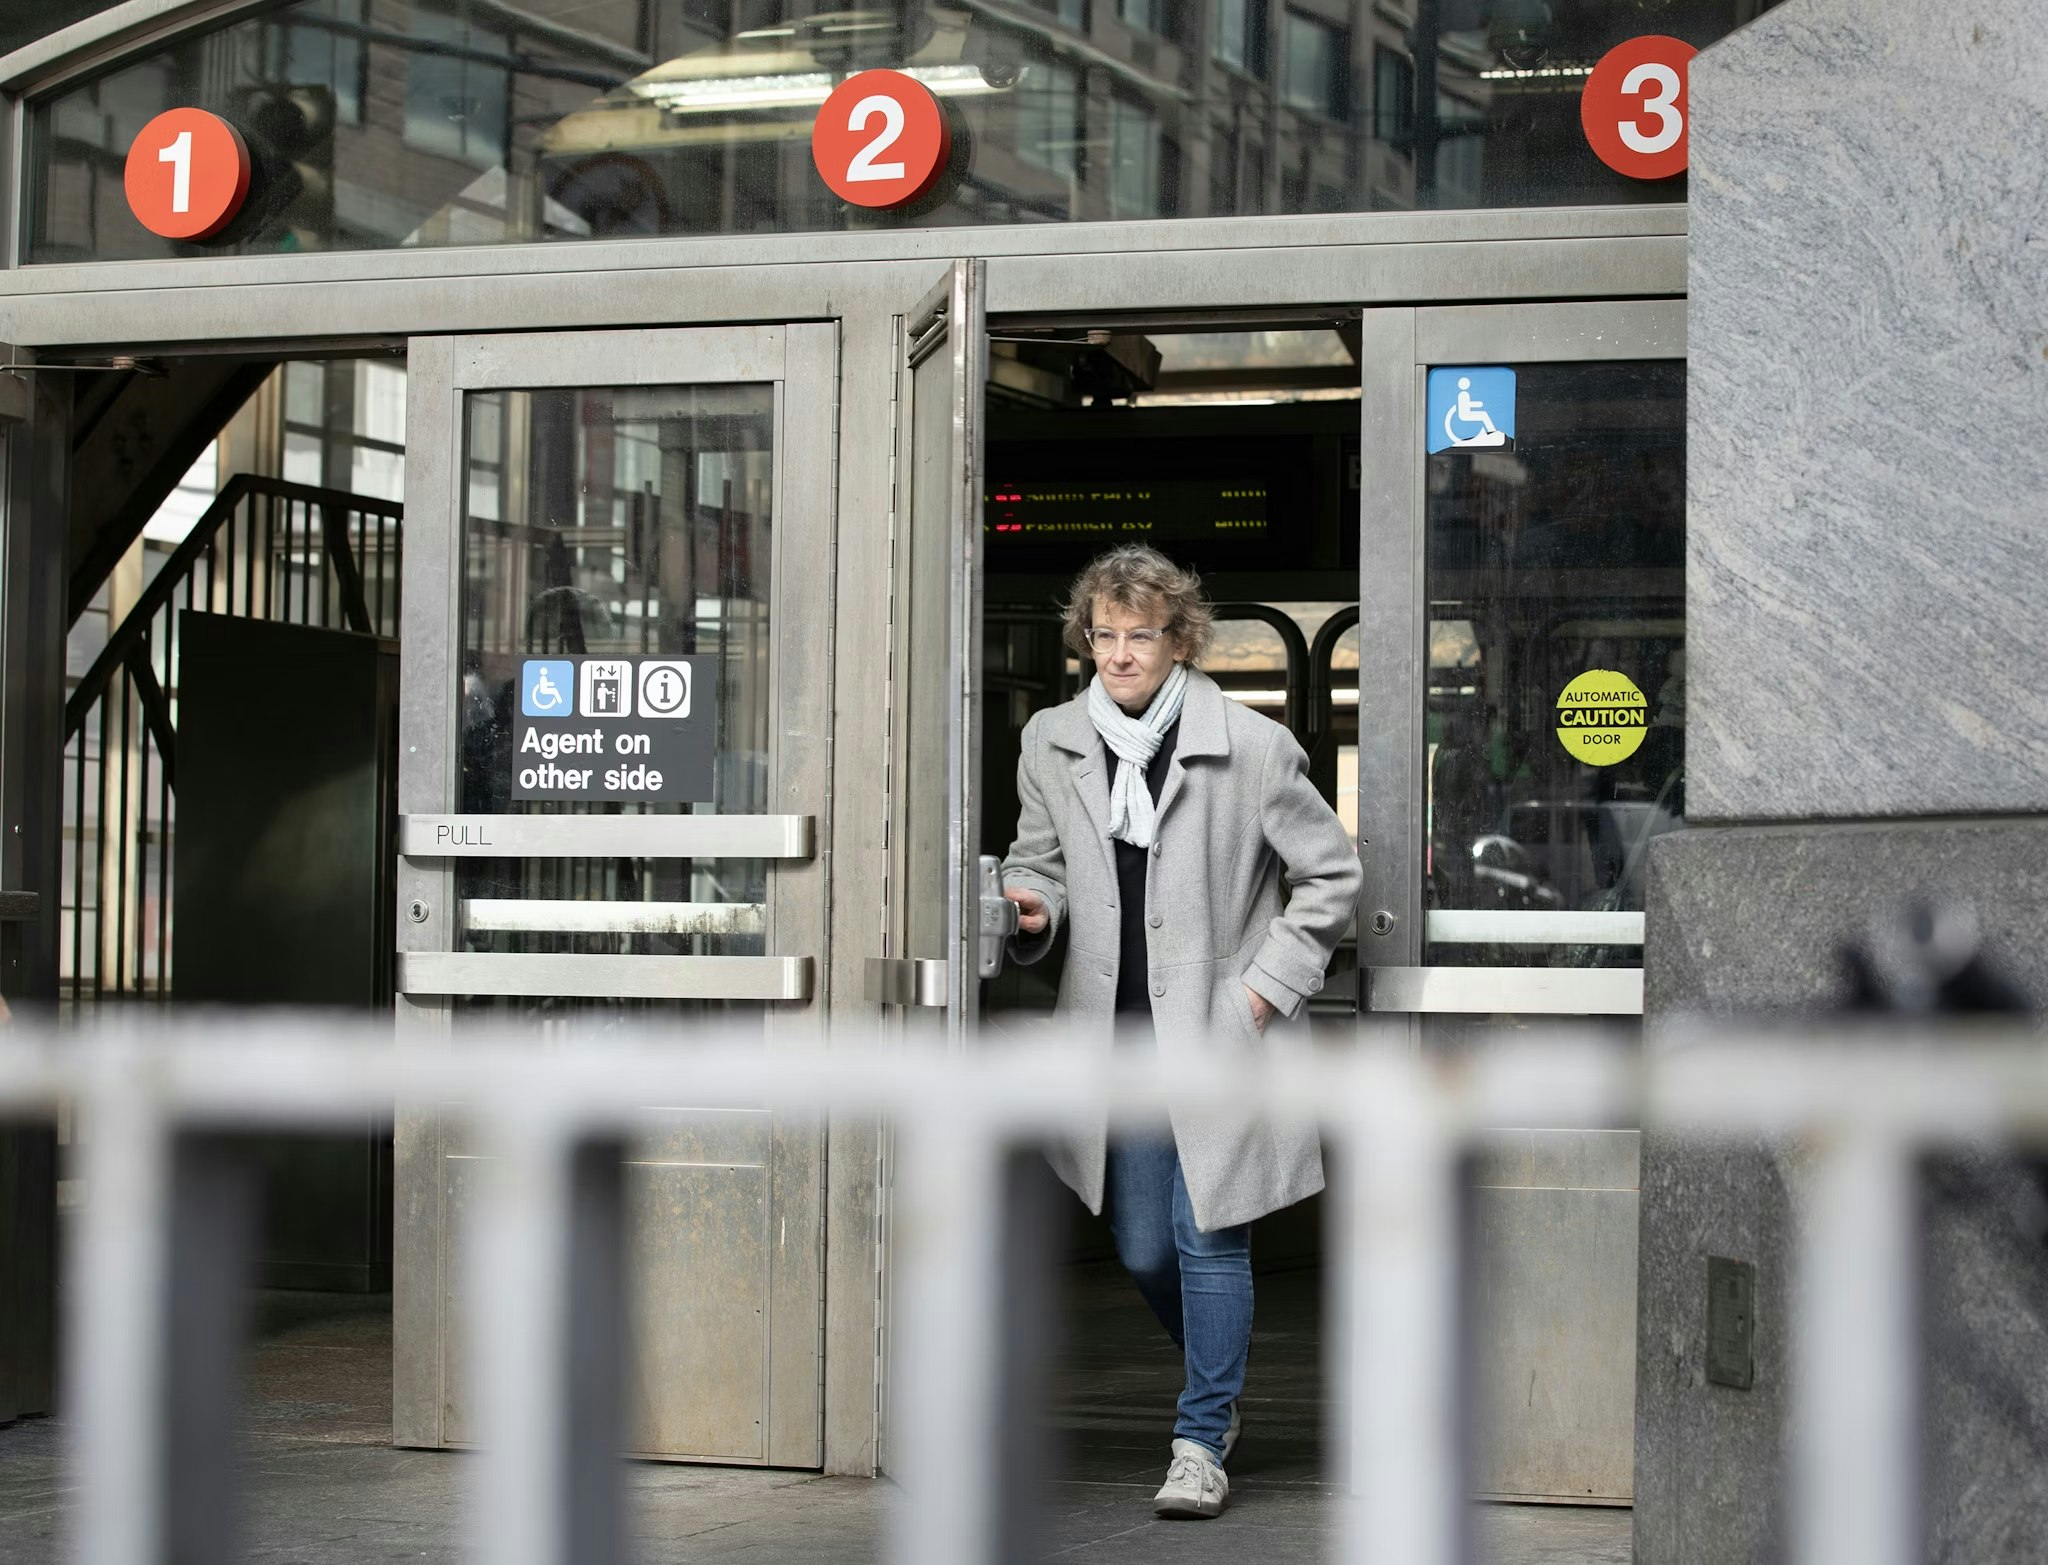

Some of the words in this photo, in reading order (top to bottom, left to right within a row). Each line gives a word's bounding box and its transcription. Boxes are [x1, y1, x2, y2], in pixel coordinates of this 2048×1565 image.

[1617, 63, 1683, 154] 3
[846, 94, 905, 182] 2
[158, 131, 192, 213] 1
[1566, 691, 1639, 702] AUTOMATIC
[1560, 709, 1644, 726] CAUTION
[520, 726, 604, 760] Agent
[614, 733, 651, 755] on
[1583, 734, 1621, 745] DOOR
[519, 762, 594, 790] other
[603, 763, 664, 791] side
[436, 825, 493, 846] PULL
